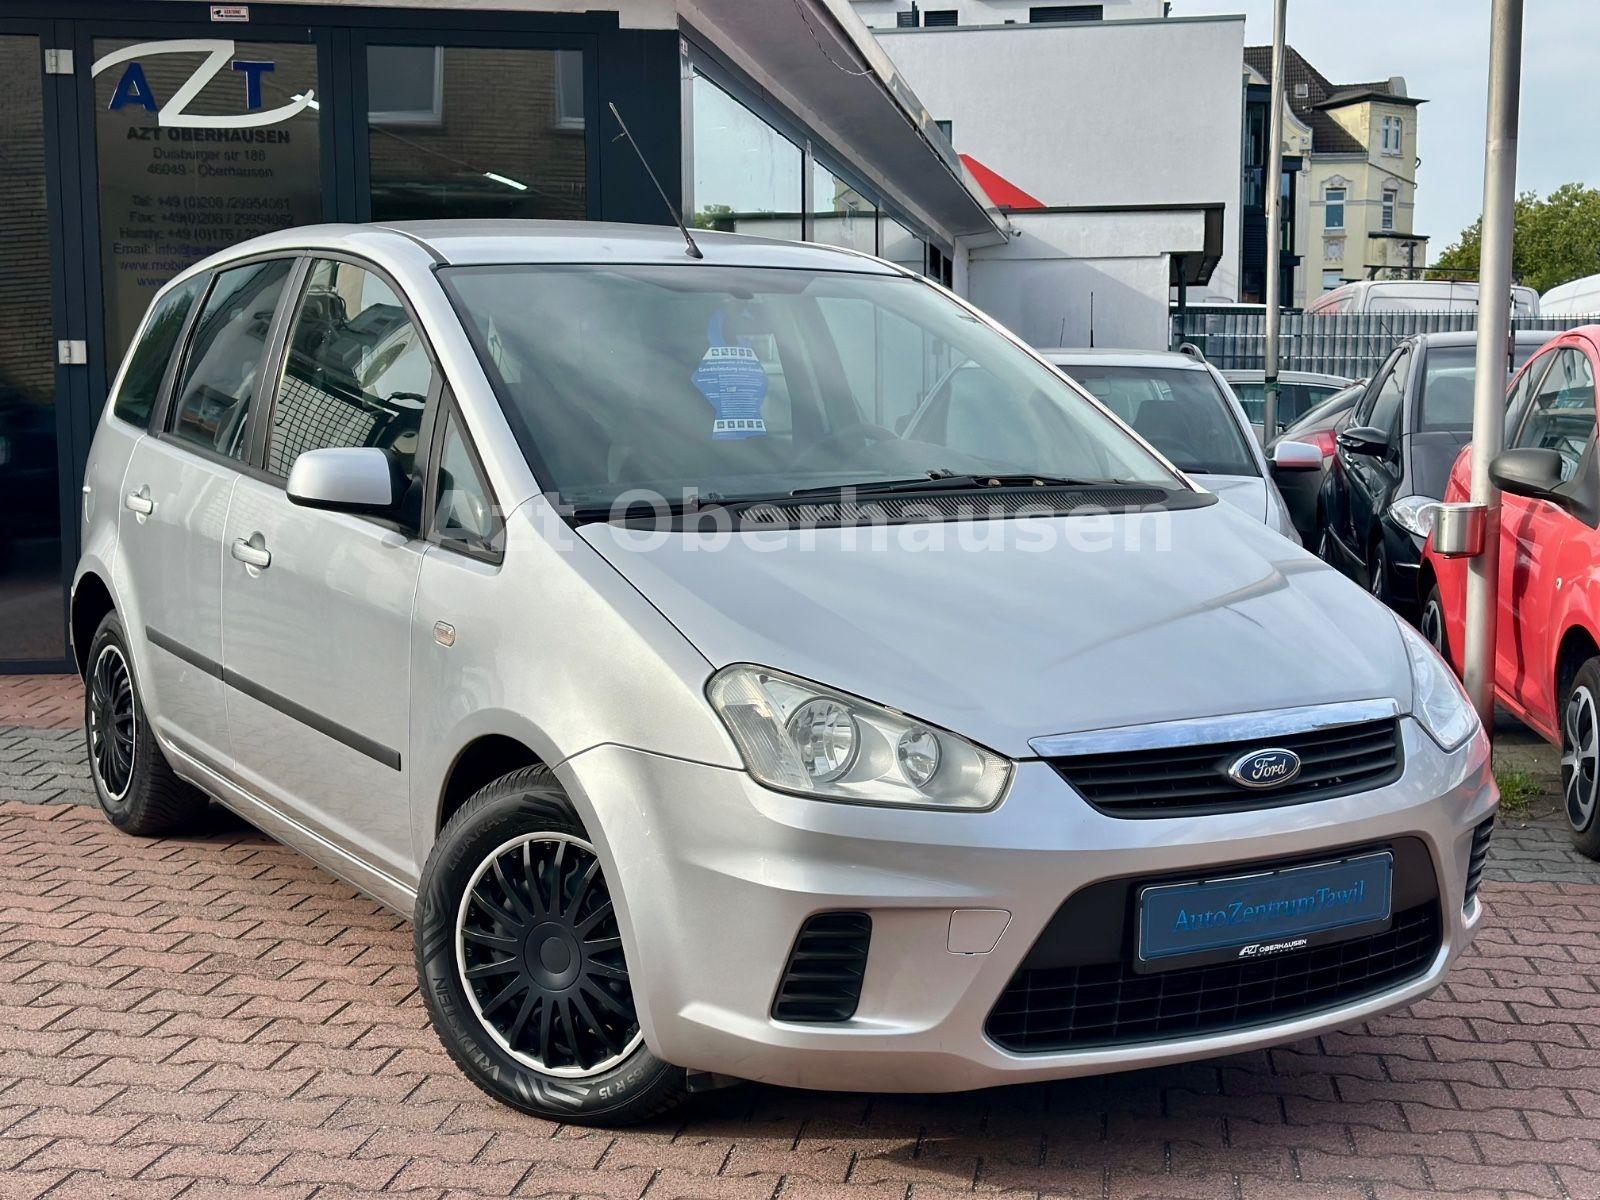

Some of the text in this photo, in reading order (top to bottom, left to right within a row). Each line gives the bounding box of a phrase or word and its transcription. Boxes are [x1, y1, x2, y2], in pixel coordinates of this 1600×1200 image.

[91, 38, 315, 128] AZT
[126, 127, 291, 144] AZT OBERHAUSEN
[198, 163, 274, 178] Oberhausen
[1252, 756, 1287, 779] Ford
[1259, 939, 1307, 953] OBERHAUSEN
